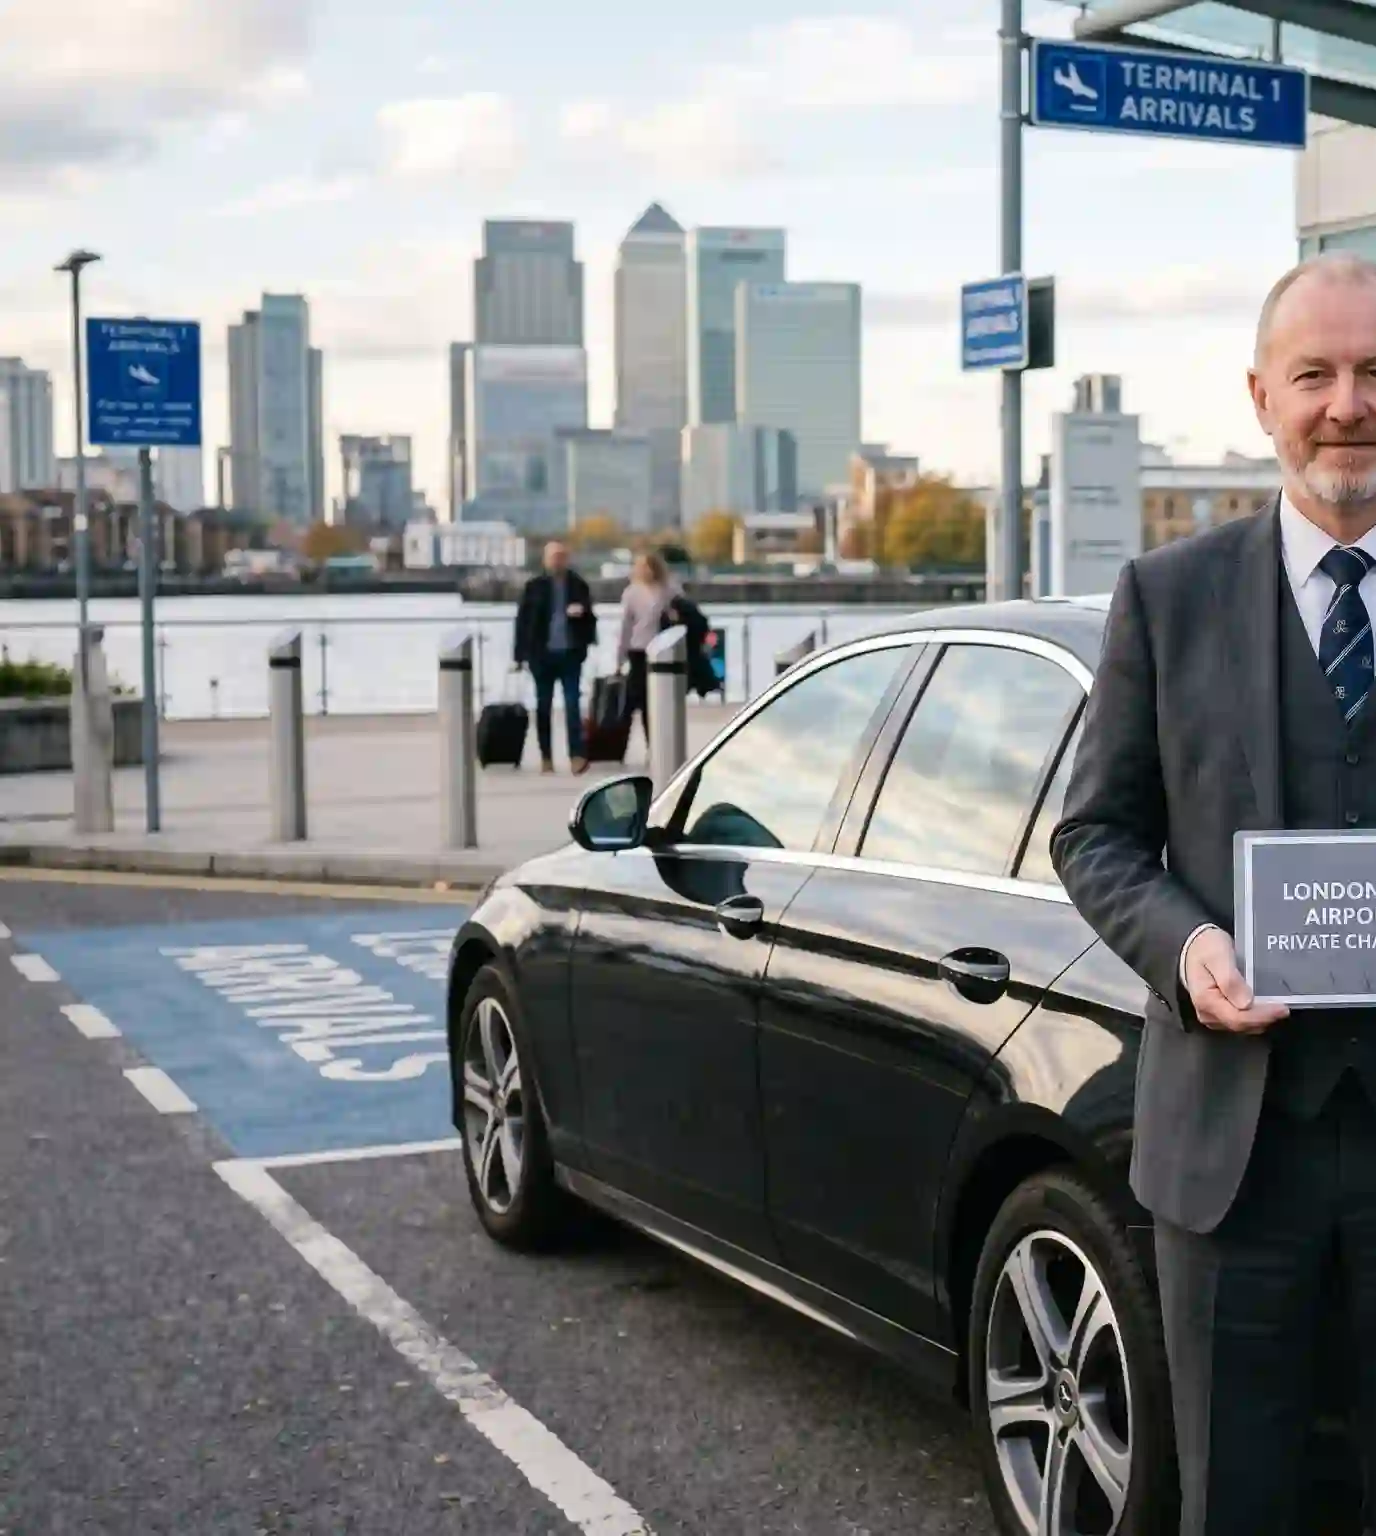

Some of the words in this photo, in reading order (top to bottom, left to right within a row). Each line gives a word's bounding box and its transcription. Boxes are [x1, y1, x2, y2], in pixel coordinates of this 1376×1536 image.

[1120, 61, 1264, 101] TERMINAL
[1270, 79, 1281, 102] 1
[1120, 95, 1257, 133] ARRIVALS
[1267, 934, 1341, 951] PRIVATE
